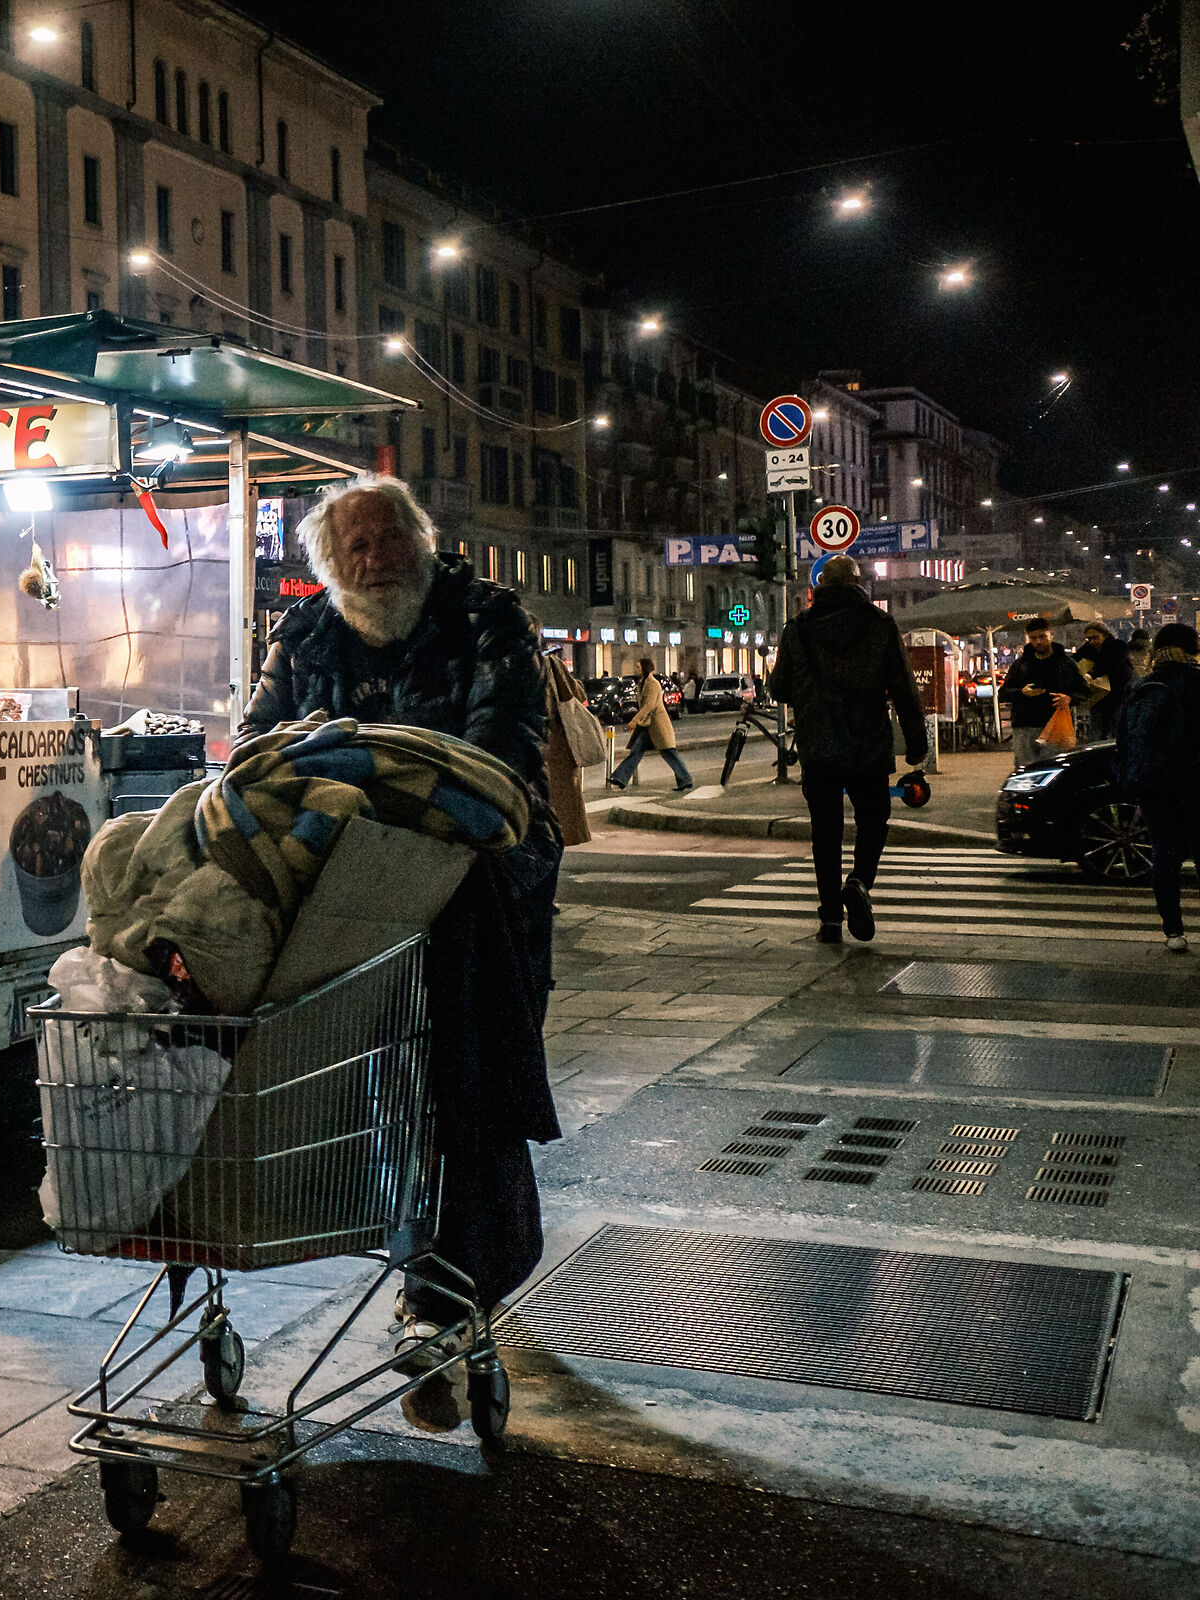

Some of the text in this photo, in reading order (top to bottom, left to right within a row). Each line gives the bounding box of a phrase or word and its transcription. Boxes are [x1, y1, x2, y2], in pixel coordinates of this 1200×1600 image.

[789, 453, 804, 463] 24
[822, 518, 848, 539] 30
[18, 763, 85, 787] CHESTNUTS
